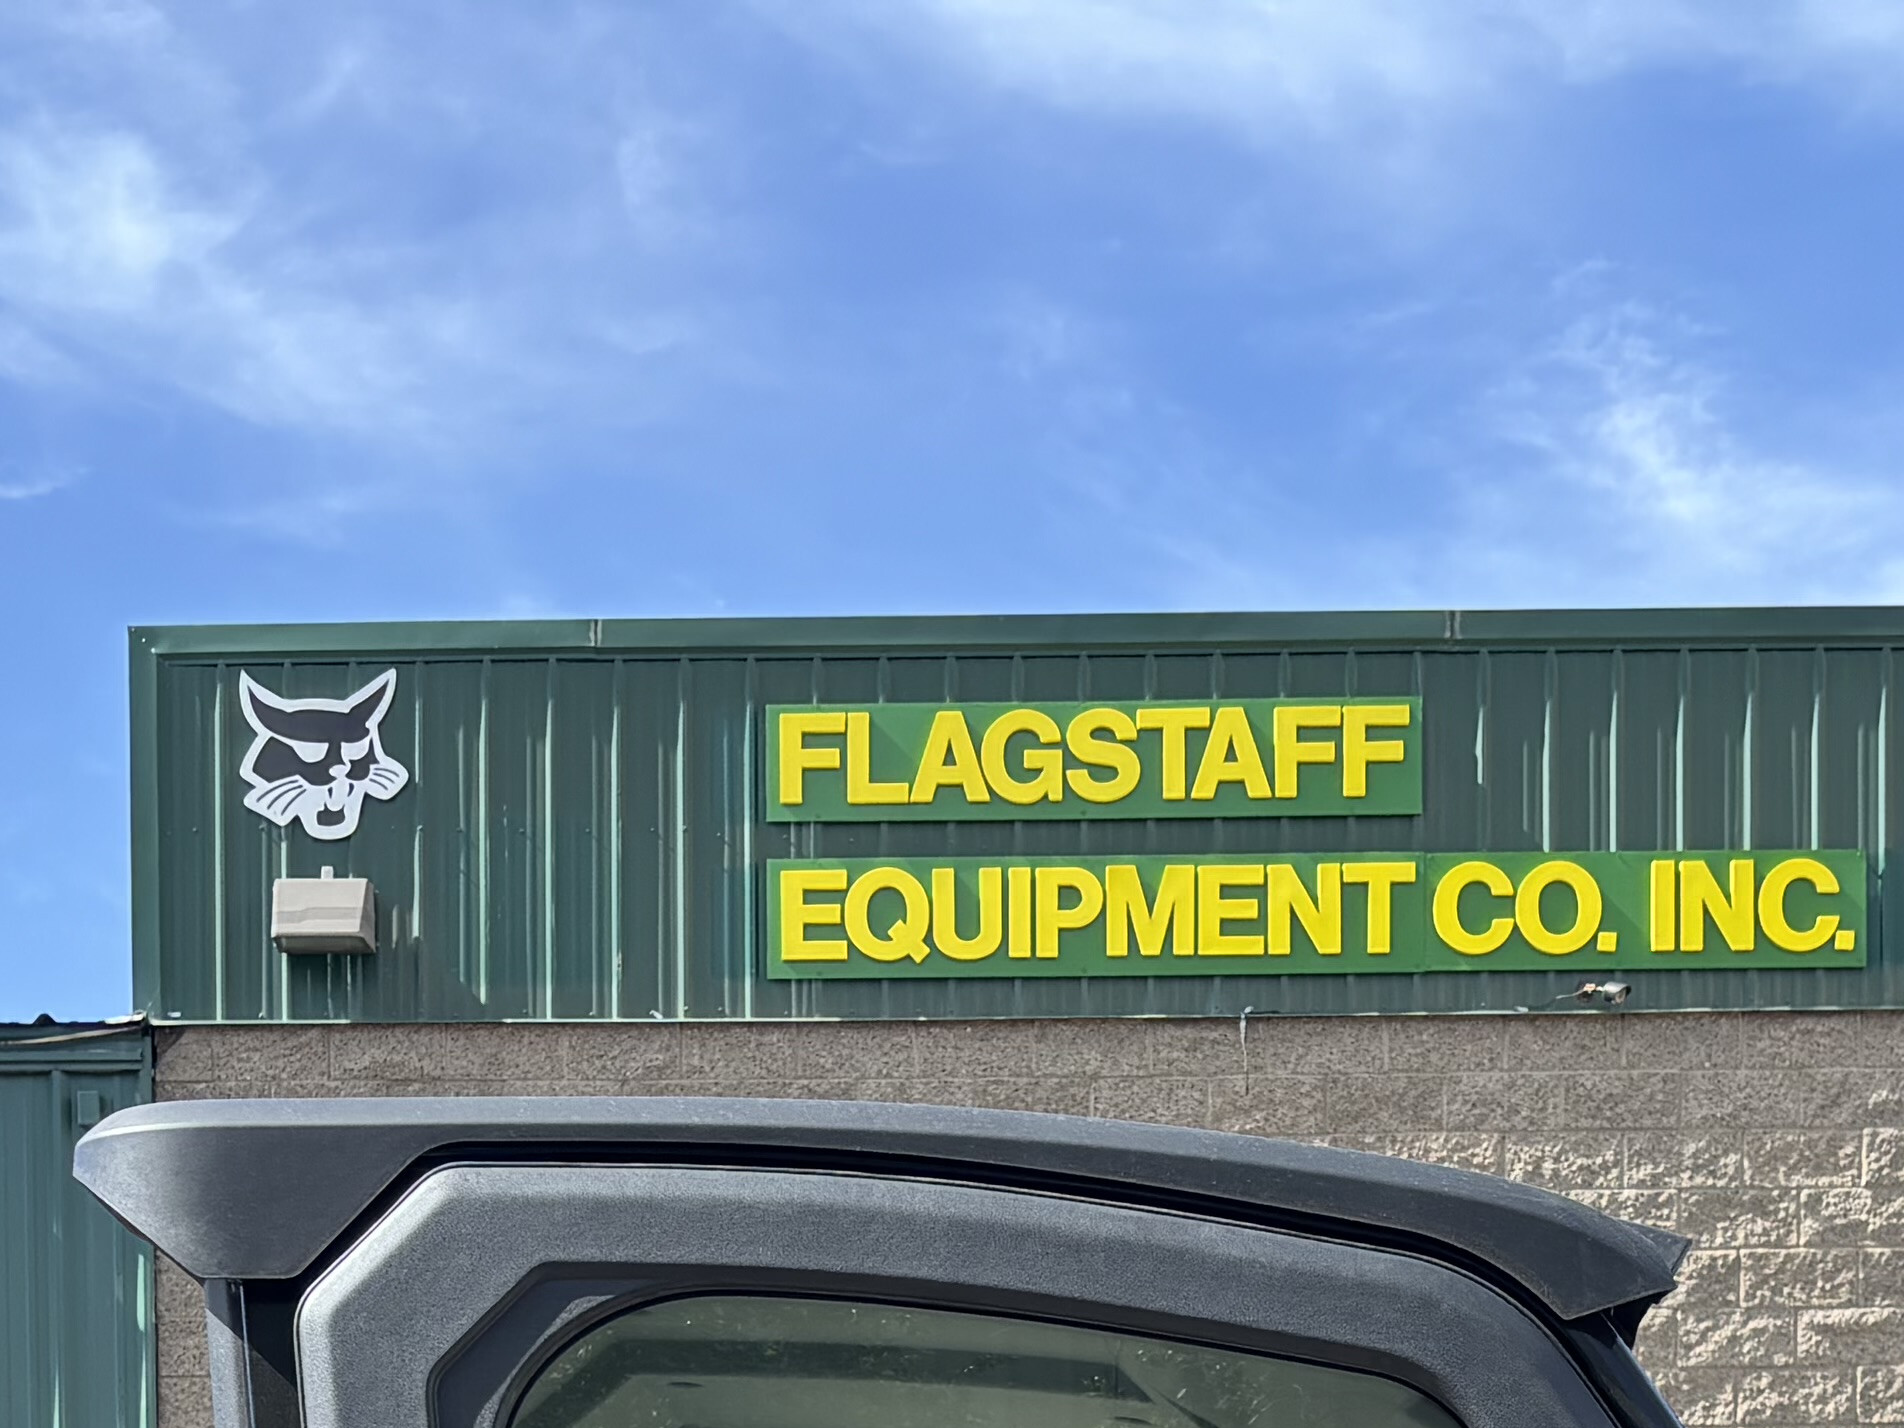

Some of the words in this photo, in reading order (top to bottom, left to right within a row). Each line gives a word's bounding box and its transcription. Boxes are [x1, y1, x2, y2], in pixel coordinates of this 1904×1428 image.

[780, 705, 1409, 803] FLAGSTAFF
[780, 862, 1415, 962] EQUIPMENT
[1434, 861, 1616, 954] CO.
[1653, 859, 1854, 951] INC.
